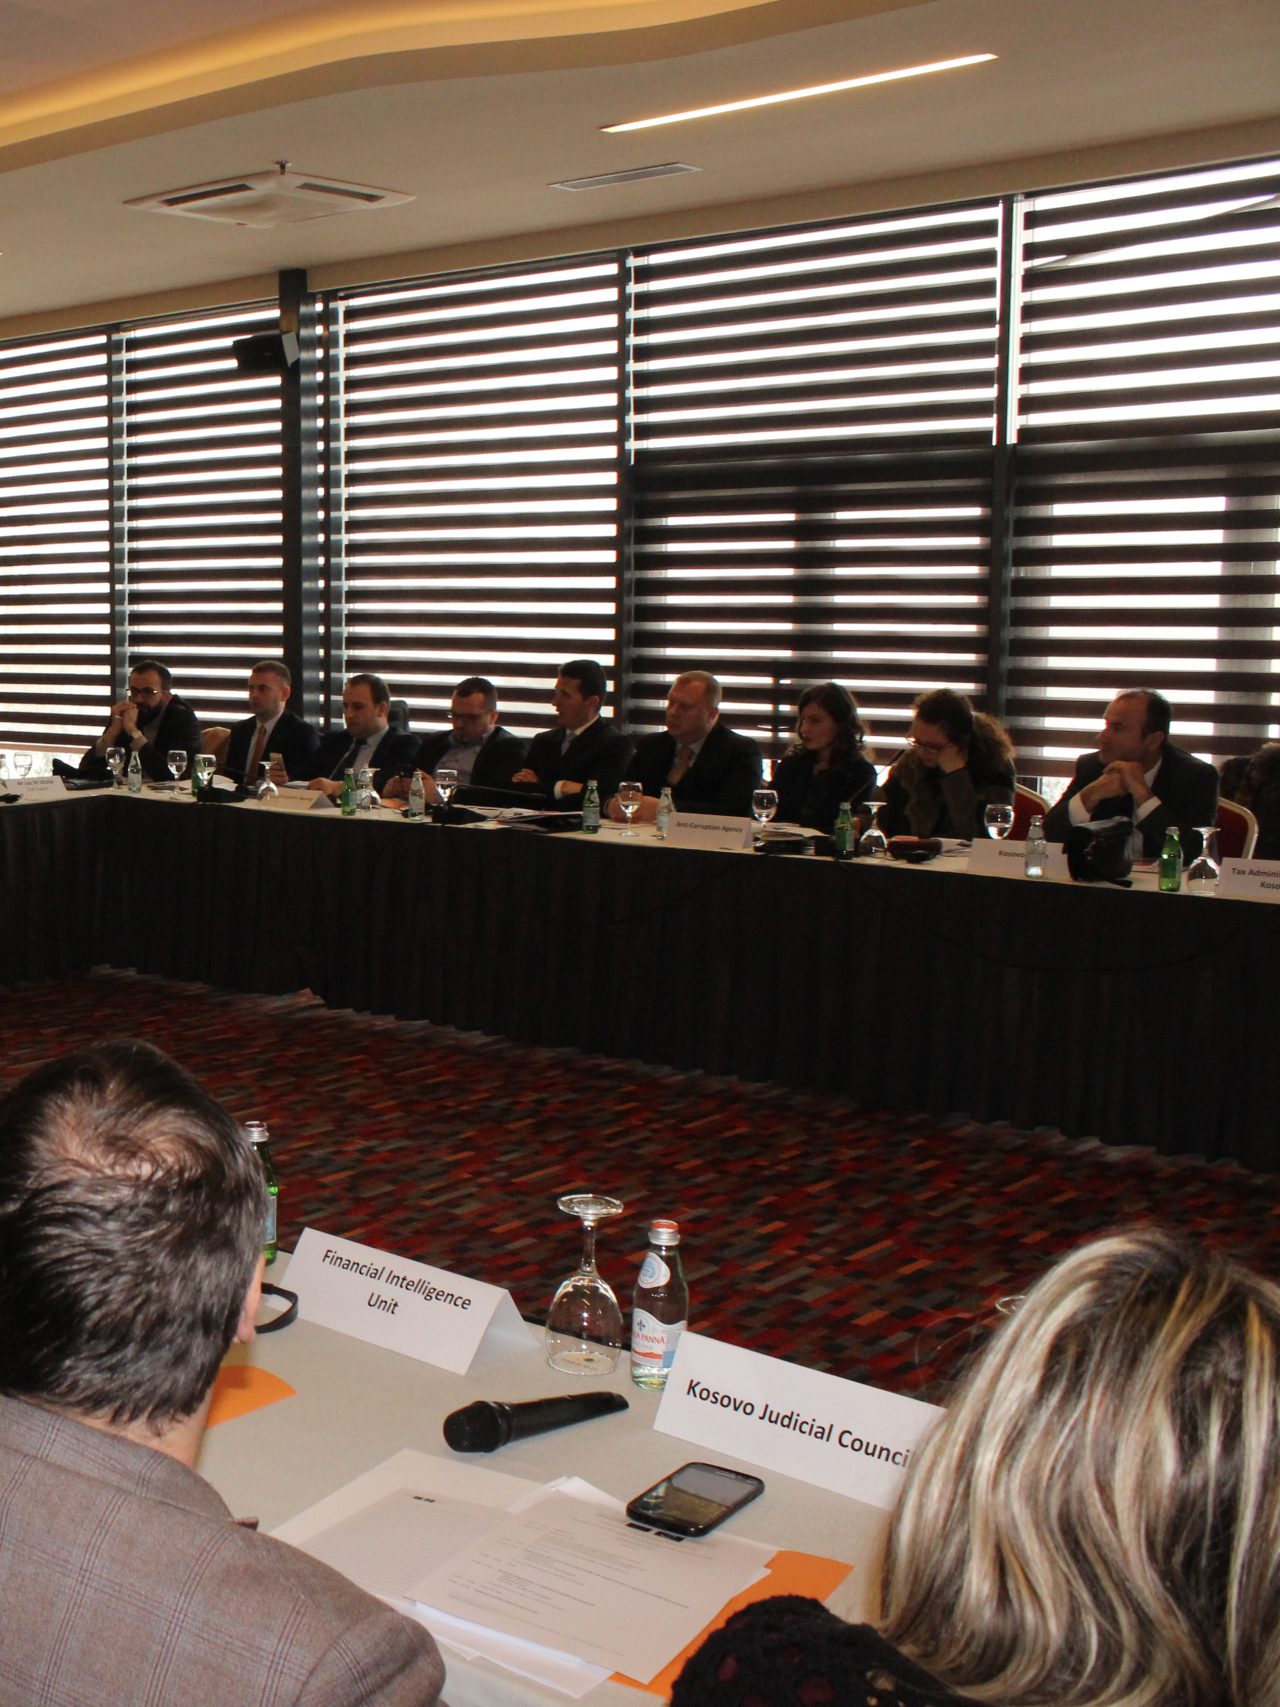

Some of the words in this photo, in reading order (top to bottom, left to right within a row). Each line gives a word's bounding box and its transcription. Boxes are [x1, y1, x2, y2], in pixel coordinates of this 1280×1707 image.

[998, 849, 1025, 858] Kosovo
[1231, 867, 1246, 875] Tax
[322, 1249, 386, 1281] Financial
[385, 1270, 472, 1310] Intelligence
[367, 1292, 399, 1315] Unit
[640, 1334, 666, 1345] PANNA
[686, 1379, 755, 1416] Kosovo
[758, 1404, 834, 1442] Judicial
[837, 1430, 910, 1468] Counci
